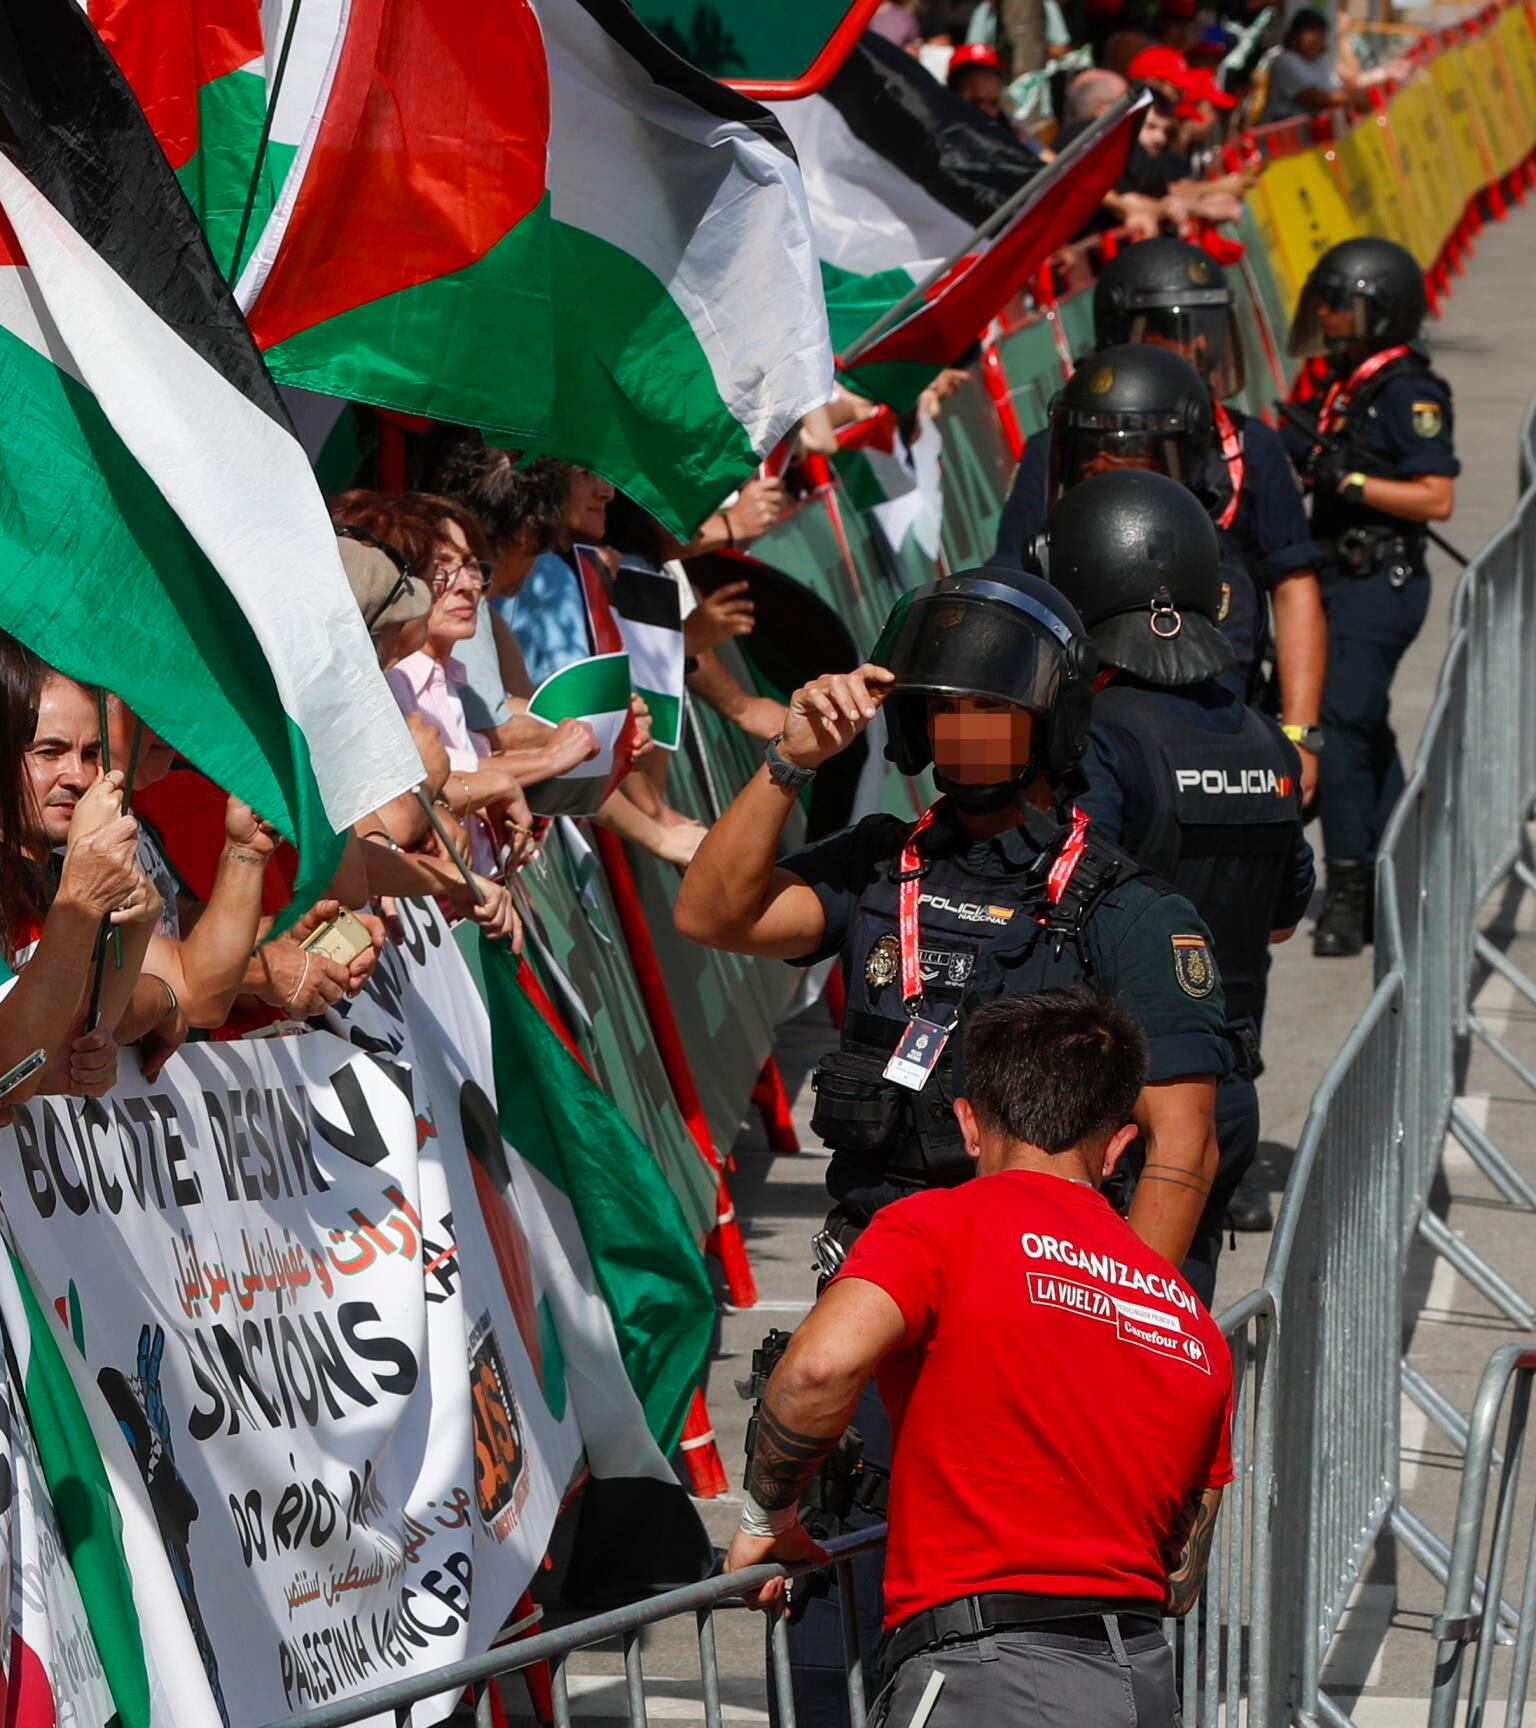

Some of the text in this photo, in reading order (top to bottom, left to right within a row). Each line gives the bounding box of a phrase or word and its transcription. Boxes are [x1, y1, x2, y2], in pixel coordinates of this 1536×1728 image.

[1020, 1231, 1200, 1321] ORGANIZACIÓN
[1036, 1277, 1112, 1317] LA VUELTA
[1123, 1320, 1179, 1350] Carrefour
[278, 1615, 378, 1713] PALESTINA
